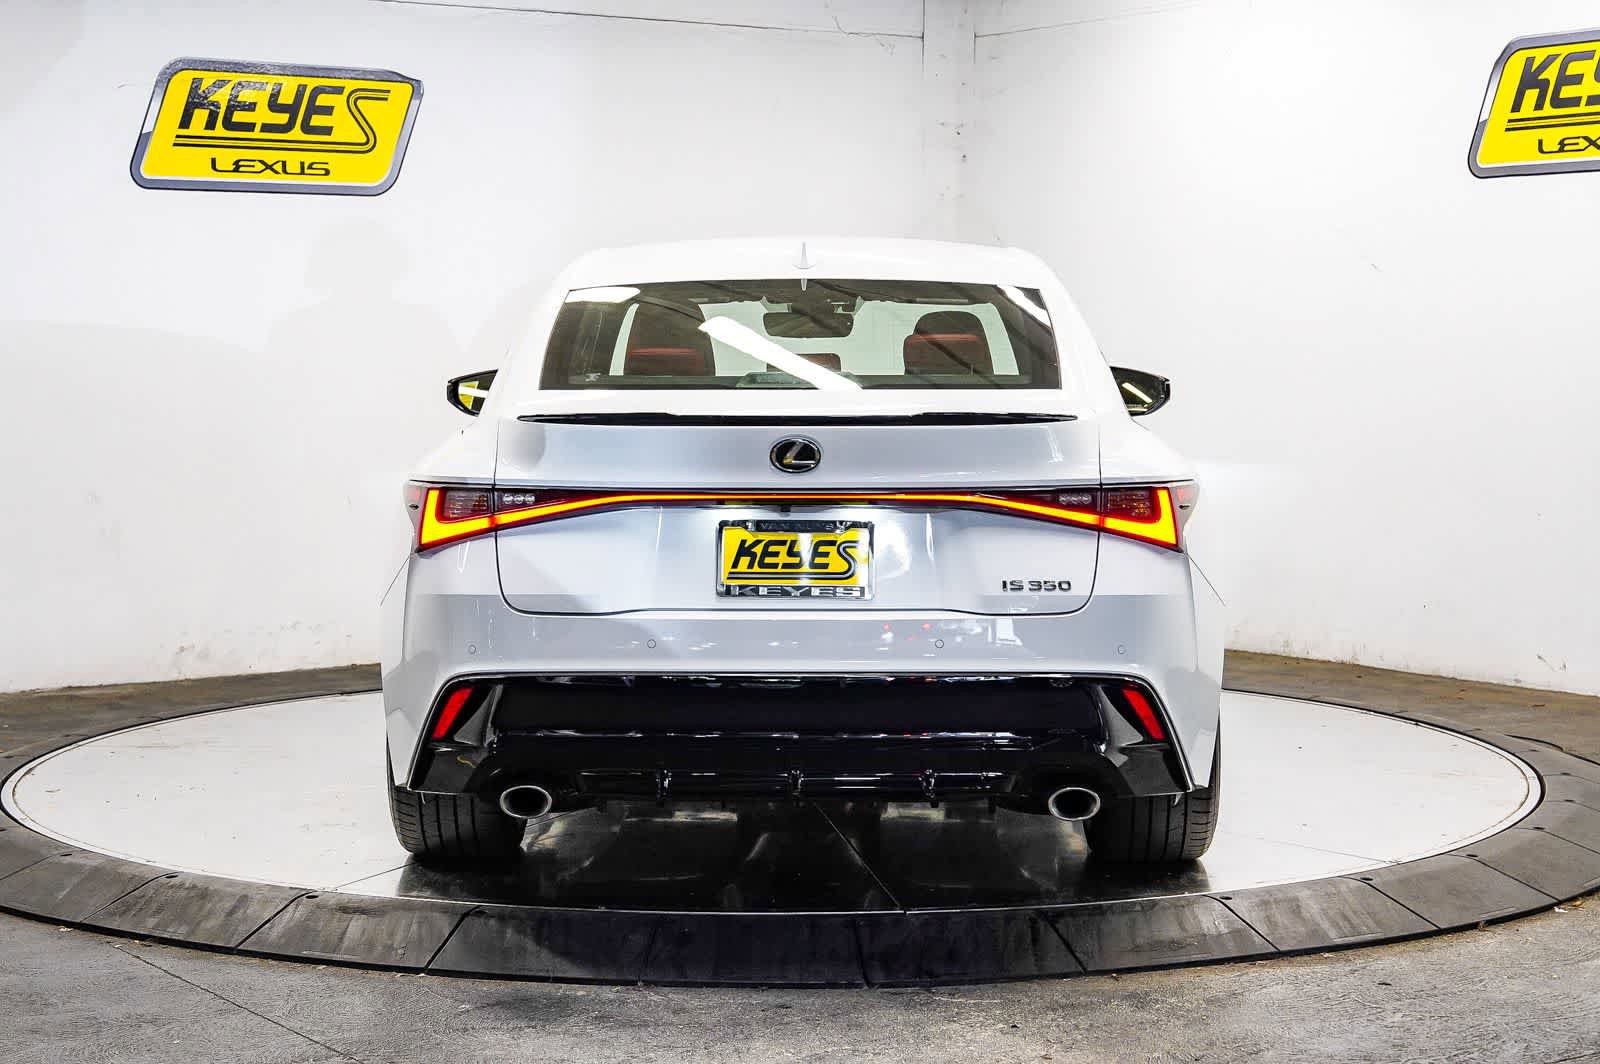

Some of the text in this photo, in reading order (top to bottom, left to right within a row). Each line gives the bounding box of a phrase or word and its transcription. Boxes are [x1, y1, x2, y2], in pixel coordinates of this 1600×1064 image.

[173, 77, 391, 154] KEYES
[210, 157, 330, 176] LEXUS
[727, 539, 861, 580] KEYES
[731, 586, 861, 597] KEYES
[1002, 580, 1072, 592] IS 350
